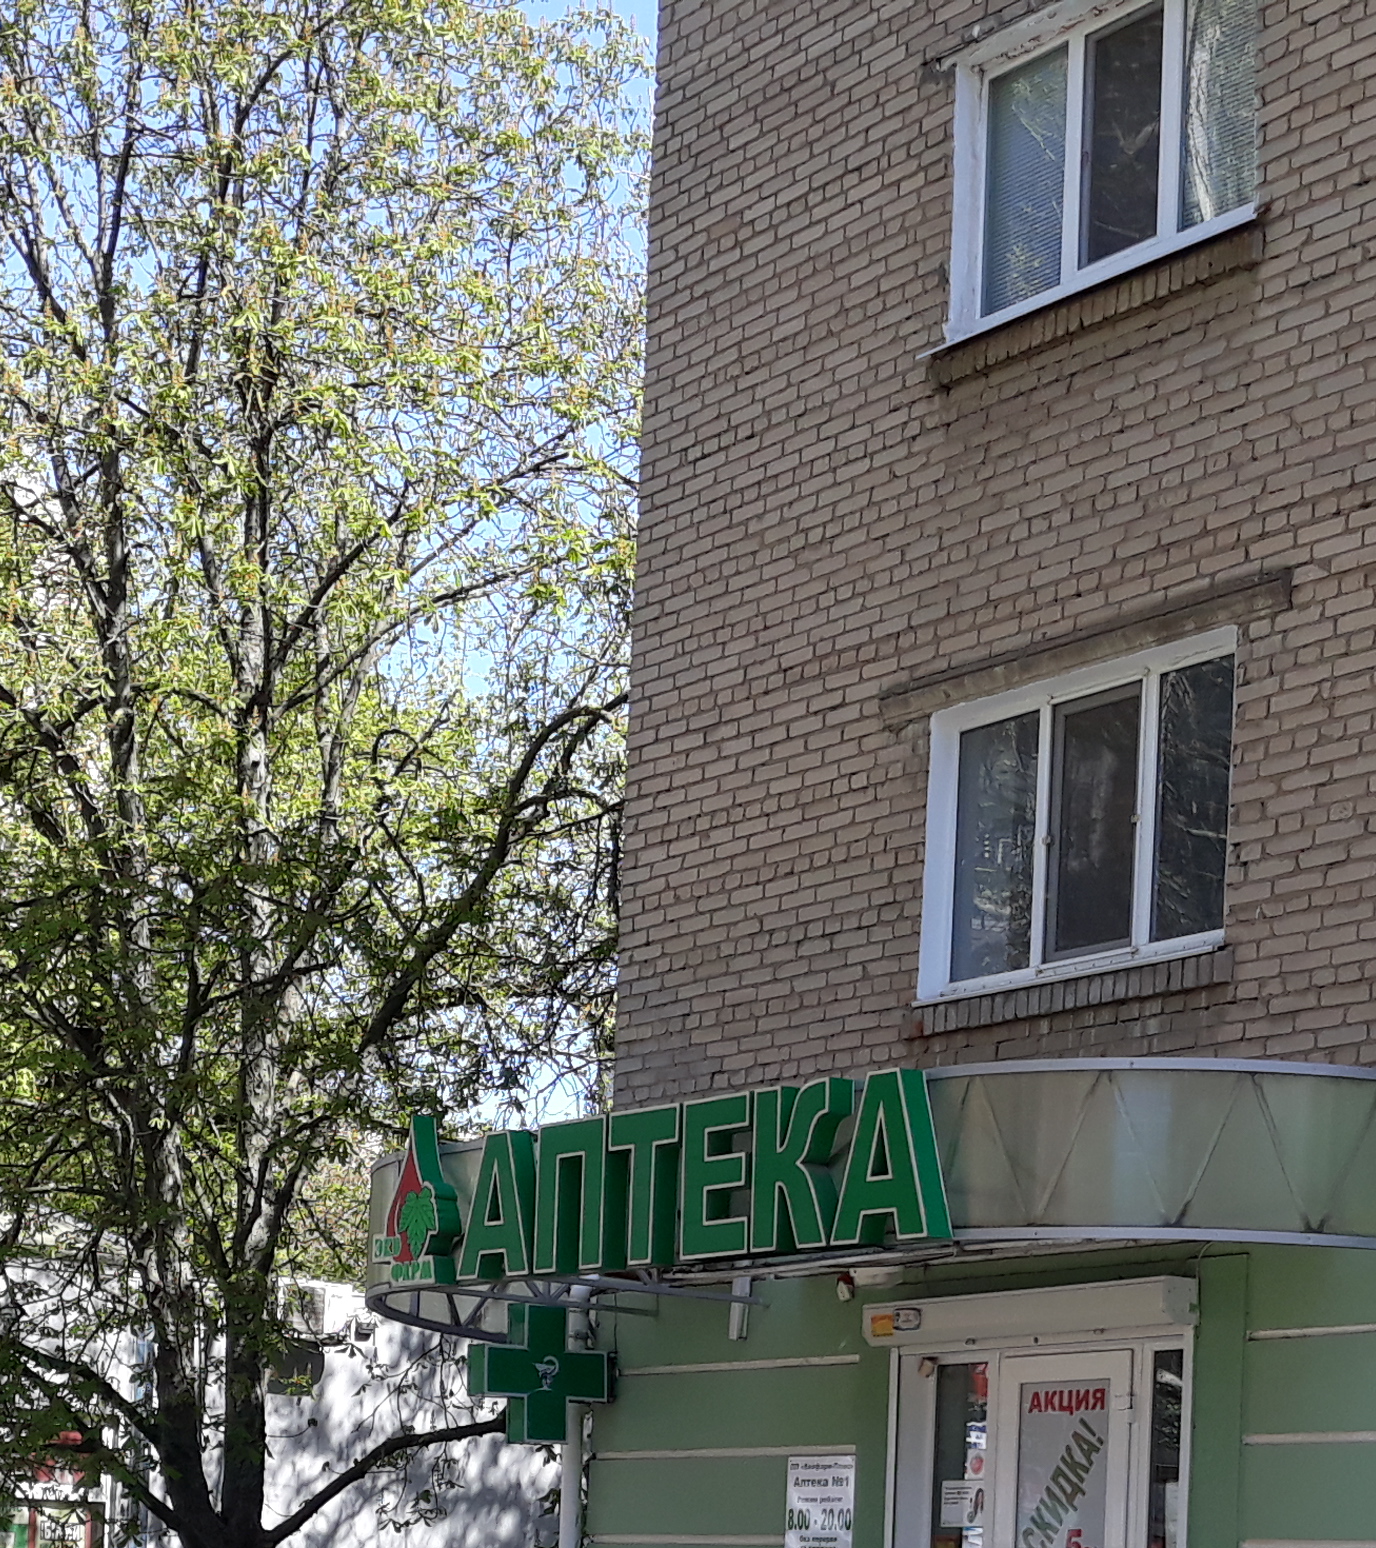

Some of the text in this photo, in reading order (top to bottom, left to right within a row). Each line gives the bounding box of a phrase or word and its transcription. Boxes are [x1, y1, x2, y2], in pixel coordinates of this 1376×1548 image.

[456, 1067, 939, 1281] АПТЕКА
[1027, 1388, 1106, 1416] АКЦИЯ
[793, 1476, 829, 1488] Аптека
[787, 1508, 811, 1531] 8.00
[820, 1508, 852, 1531] 20.00
